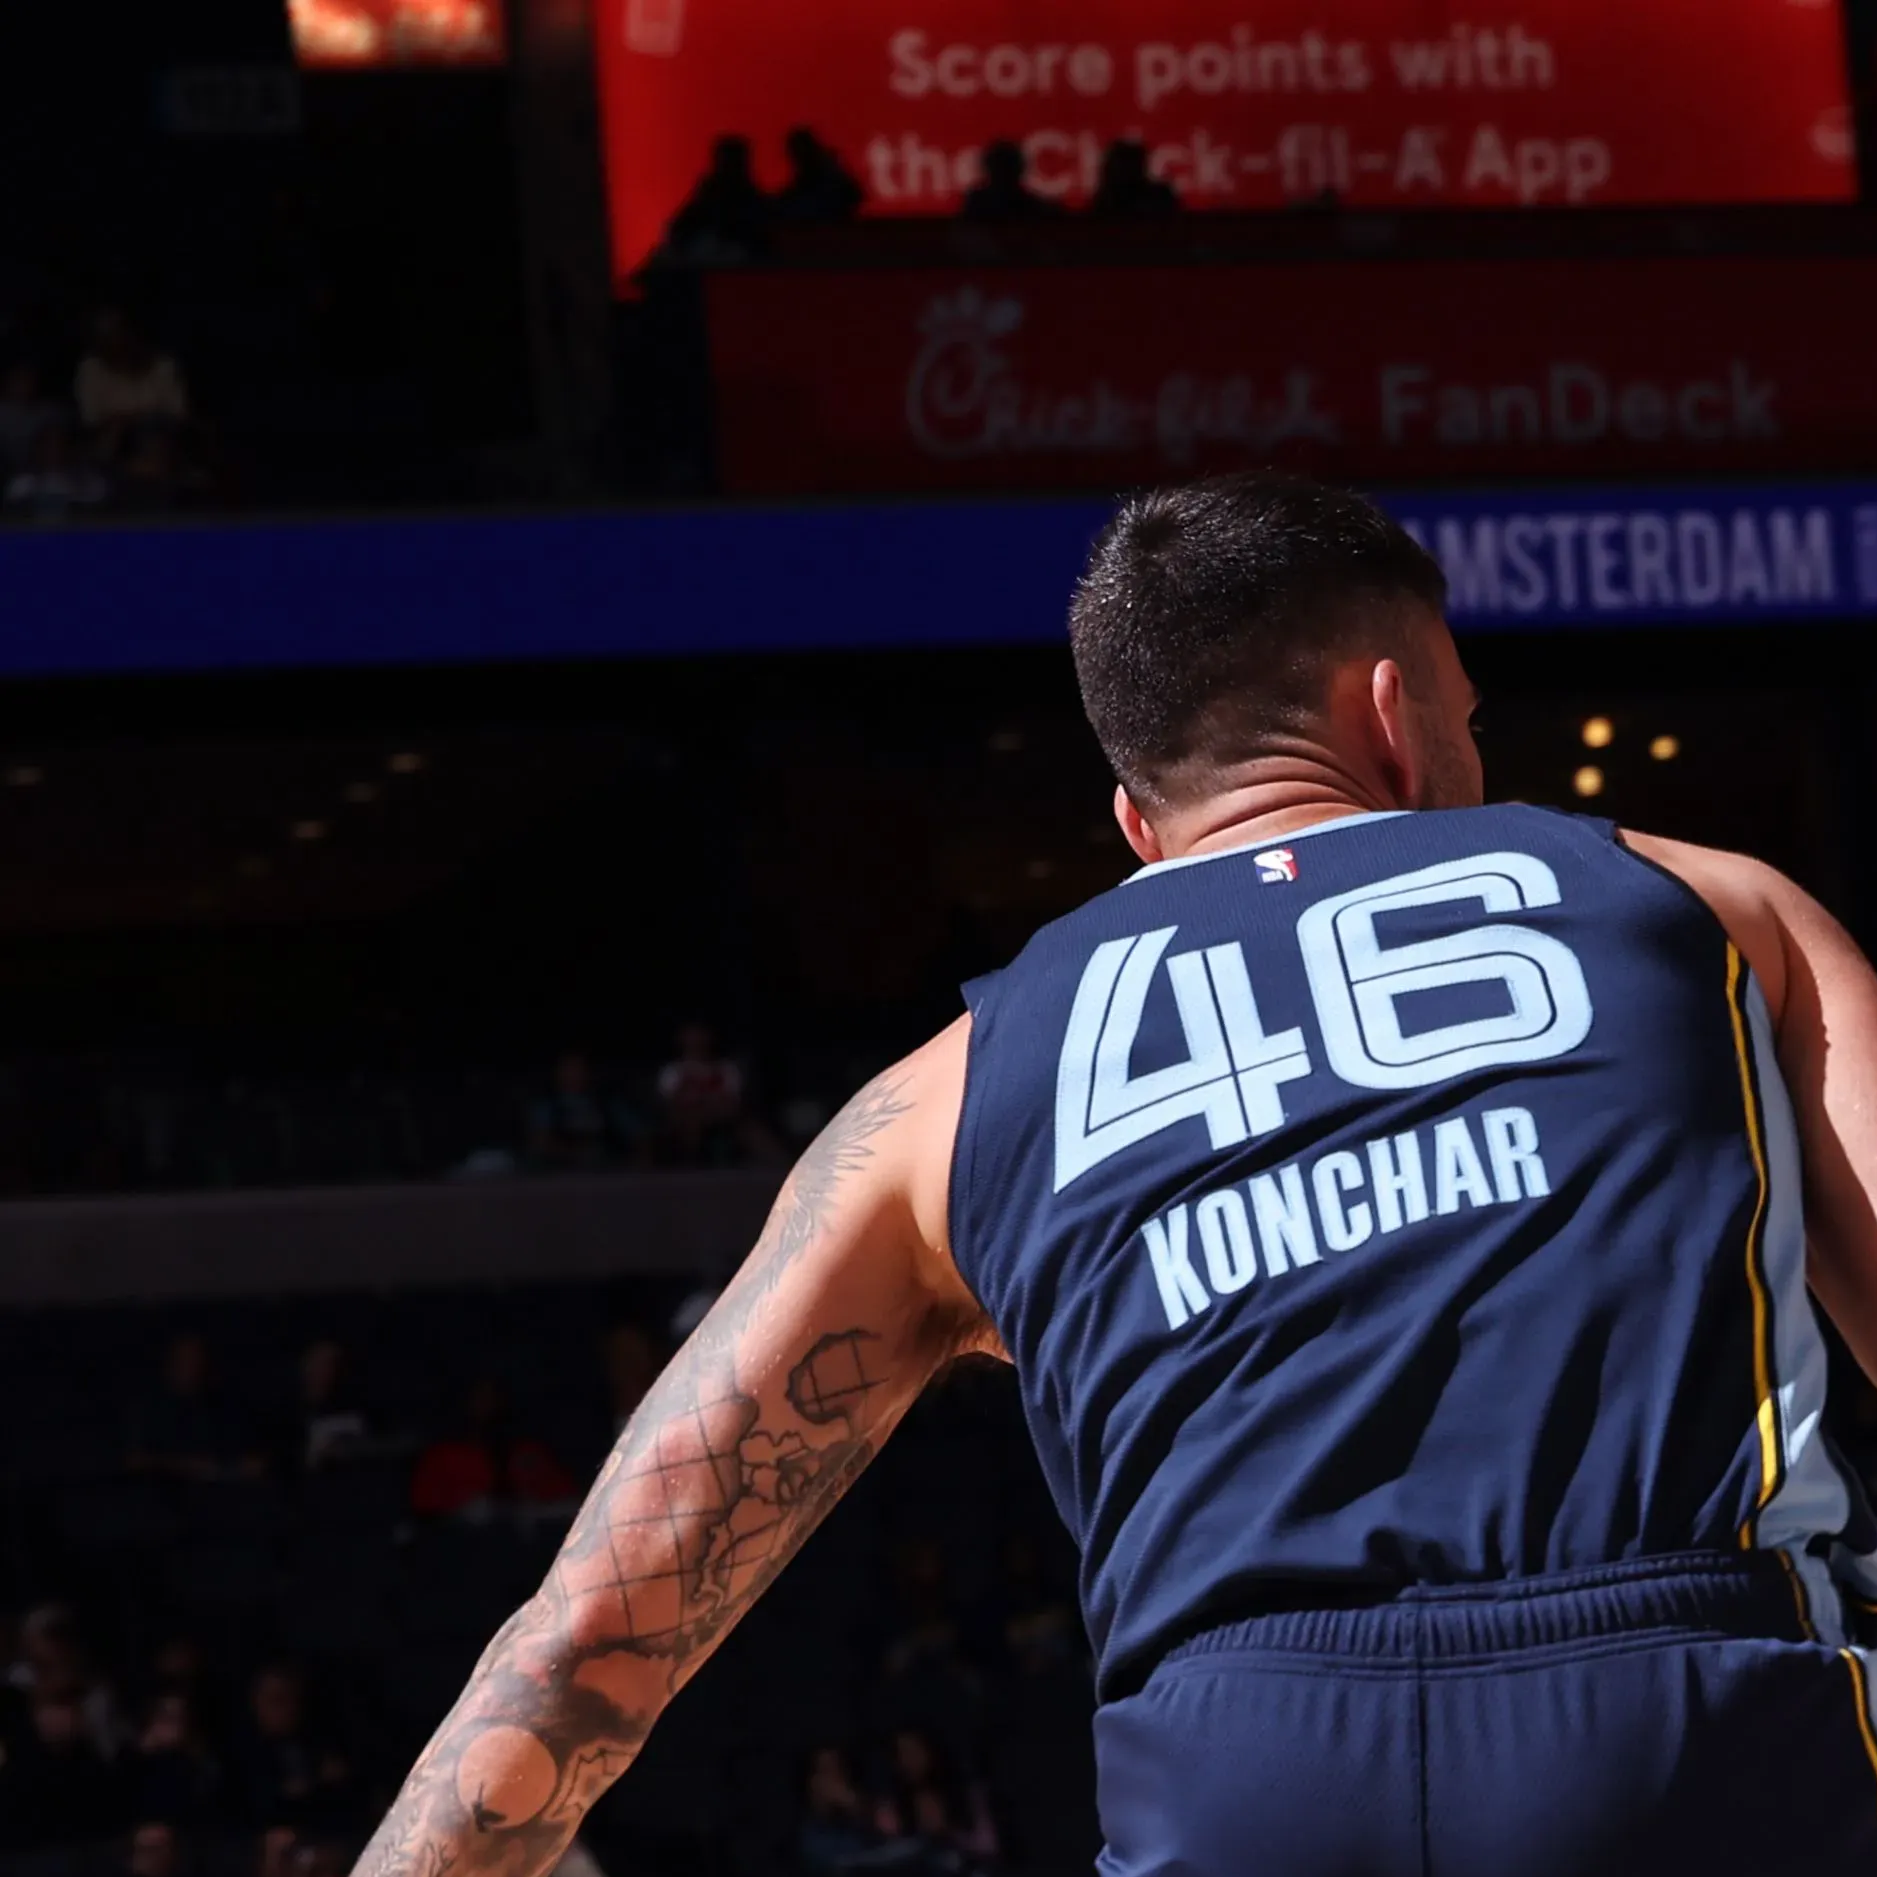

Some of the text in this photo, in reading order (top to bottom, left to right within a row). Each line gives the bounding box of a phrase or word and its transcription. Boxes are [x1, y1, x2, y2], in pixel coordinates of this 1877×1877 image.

[888, 20, 1558, 112] Score points with
[1460, 121, 1614, 208] App
[1379, 356, 1782, 447] FanDeck
[1054, 851, 1594, 1195] 46
[1139, 1106, 1552, 1332] KONCHAR
